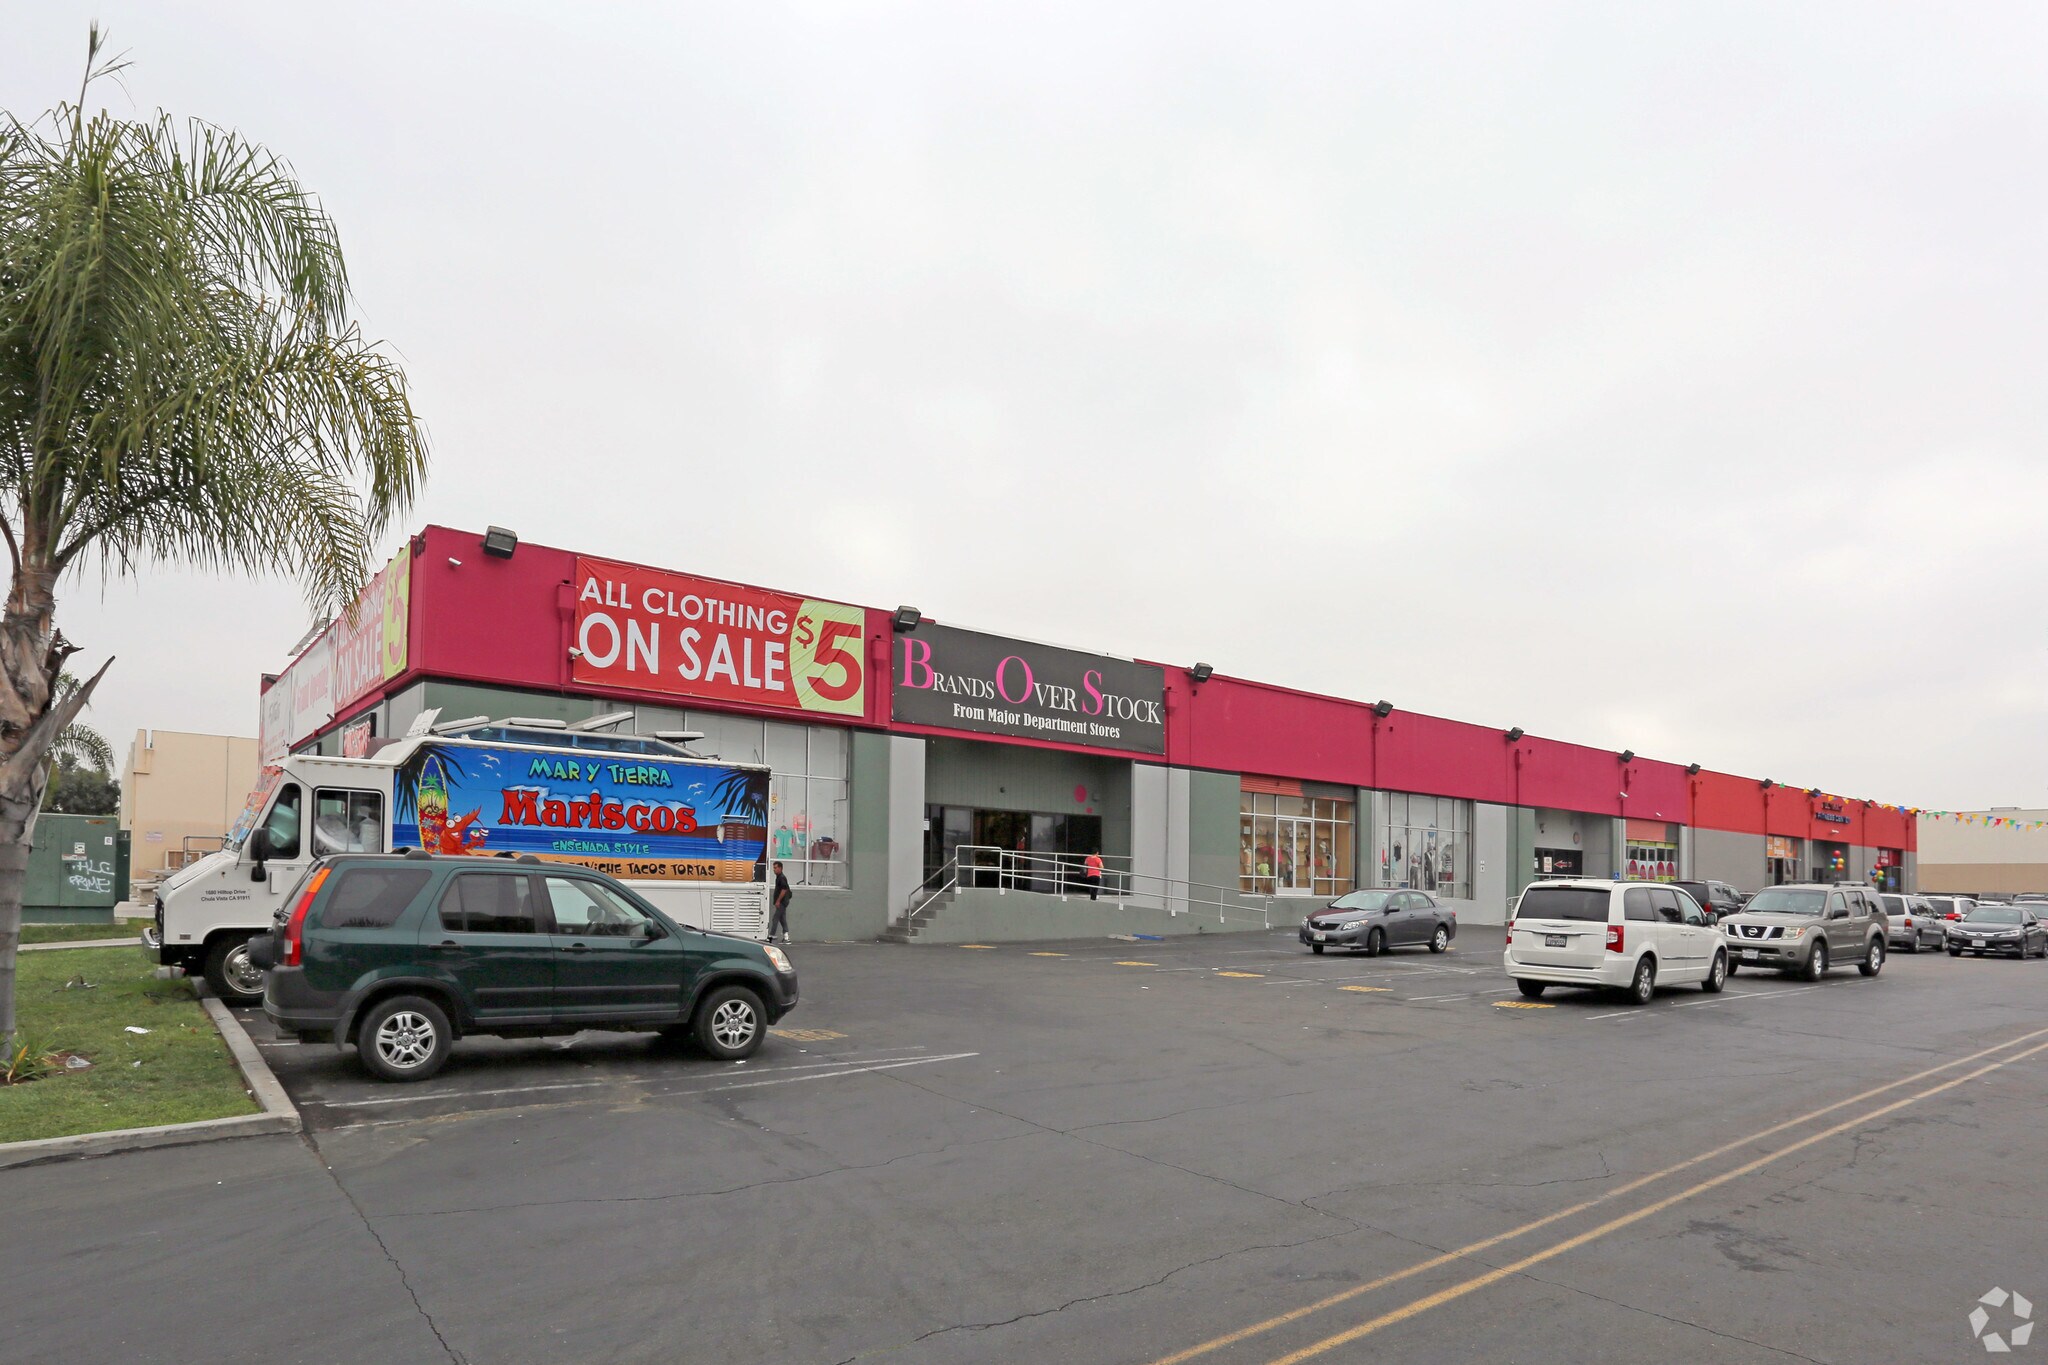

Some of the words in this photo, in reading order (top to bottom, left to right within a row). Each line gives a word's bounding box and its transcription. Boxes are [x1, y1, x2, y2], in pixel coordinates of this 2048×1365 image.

[388, 559, 407, 666] $5
[579, 577, 632, 609] ALL
[642, 588, 788, 634] CLOTHING
[336, 648, 352, 704] ON
[354, 621, 382, 689] SALE
[579, 612, 660, 675] ON
[677, 627, 785, 692] SALE
[795, 615, 862, 701] $5
[953, 703, 985, 720] From
[988, 708, 1020, 726] Major
[1023, 713, 1087, 735] Department
[1090, 722, 1120, 738] Stores
[529, 758, 580, 780] MAR
[586, 763, 600, 782] Y
[498, 789, 698, 833] Mariscos
[552, 840, 610, 853] ENSENADA
[614, 843, 649, 854] STYLE
[628, 863, 666, 876] TACOS
[670, 864, 715, 877] TORTAS
